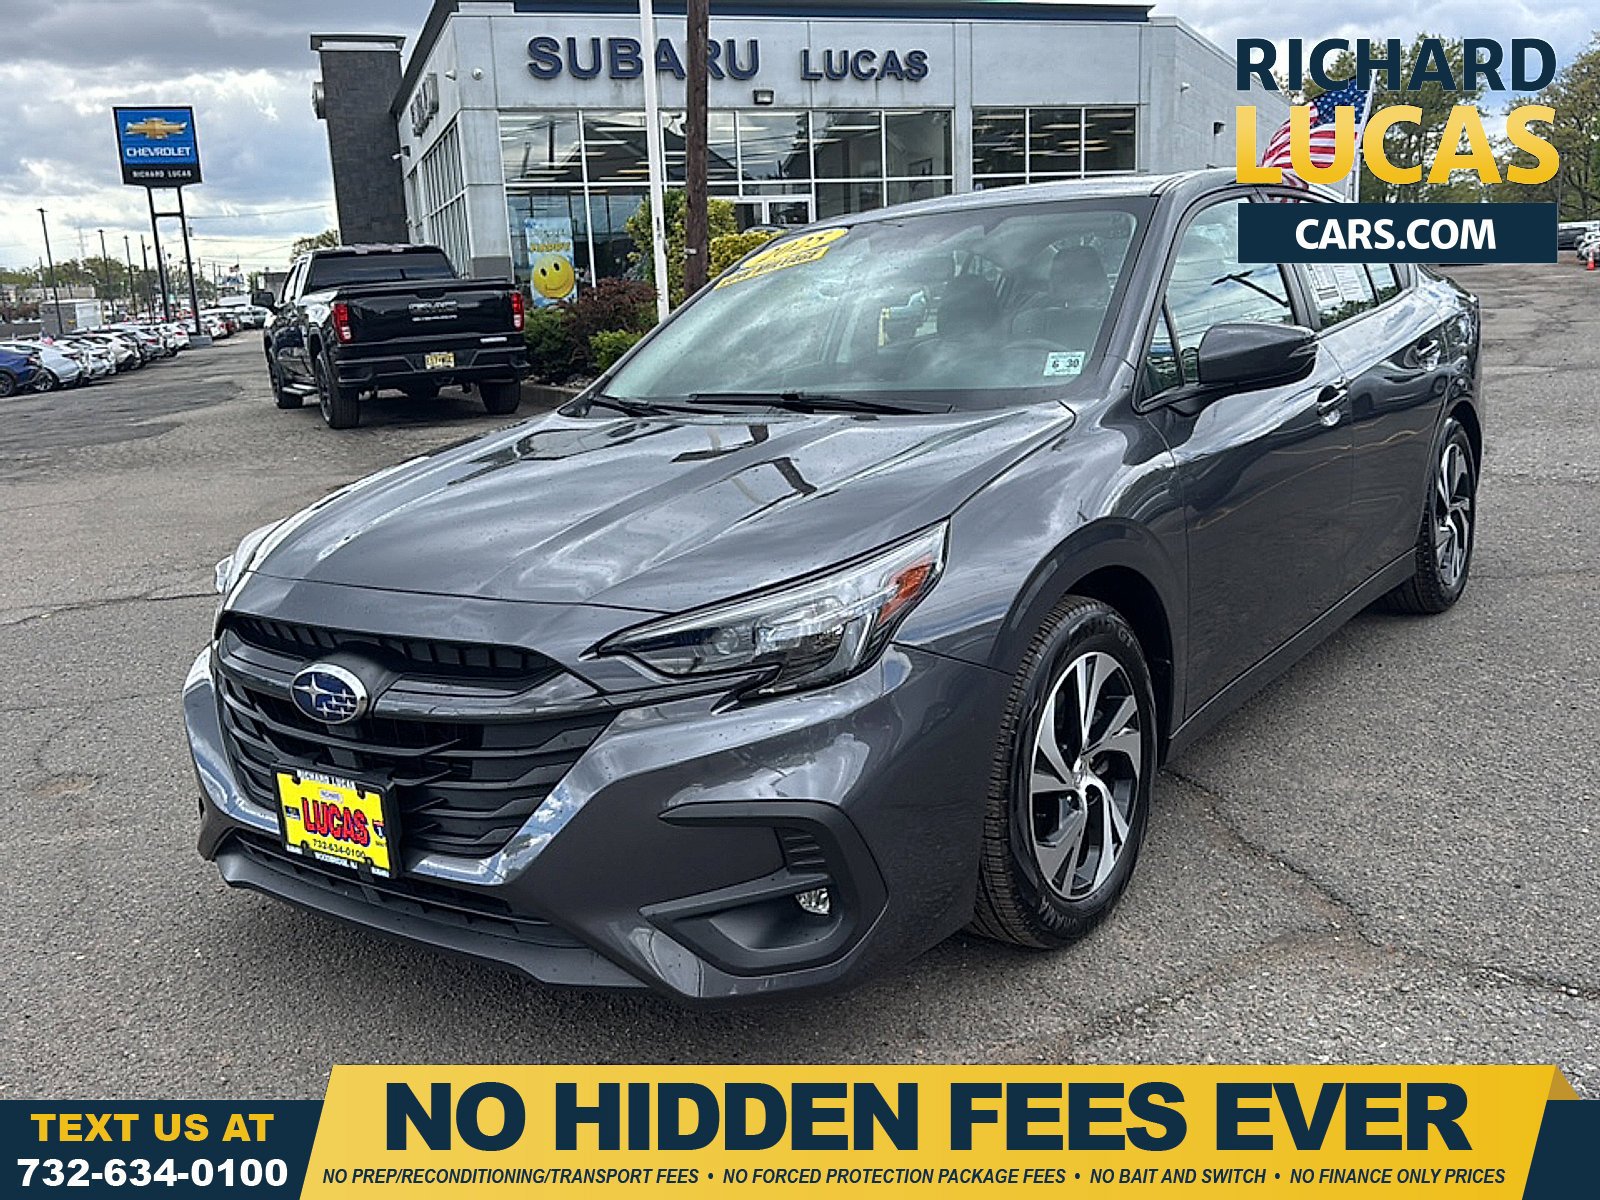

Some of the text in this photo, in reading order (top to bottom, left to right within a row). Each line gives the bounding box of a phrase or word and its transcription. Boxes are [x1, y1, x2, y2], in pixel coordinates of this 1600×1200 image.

[800, 48, 928, 82] LUCAS
[126, 146, 191, 157] CHEVROLET
[132, 169, 192, 178] RICHARD LUCAS
[301, 796, 370, 847] LUCAS
[312, 838, 367, 858] 732-634-0100
